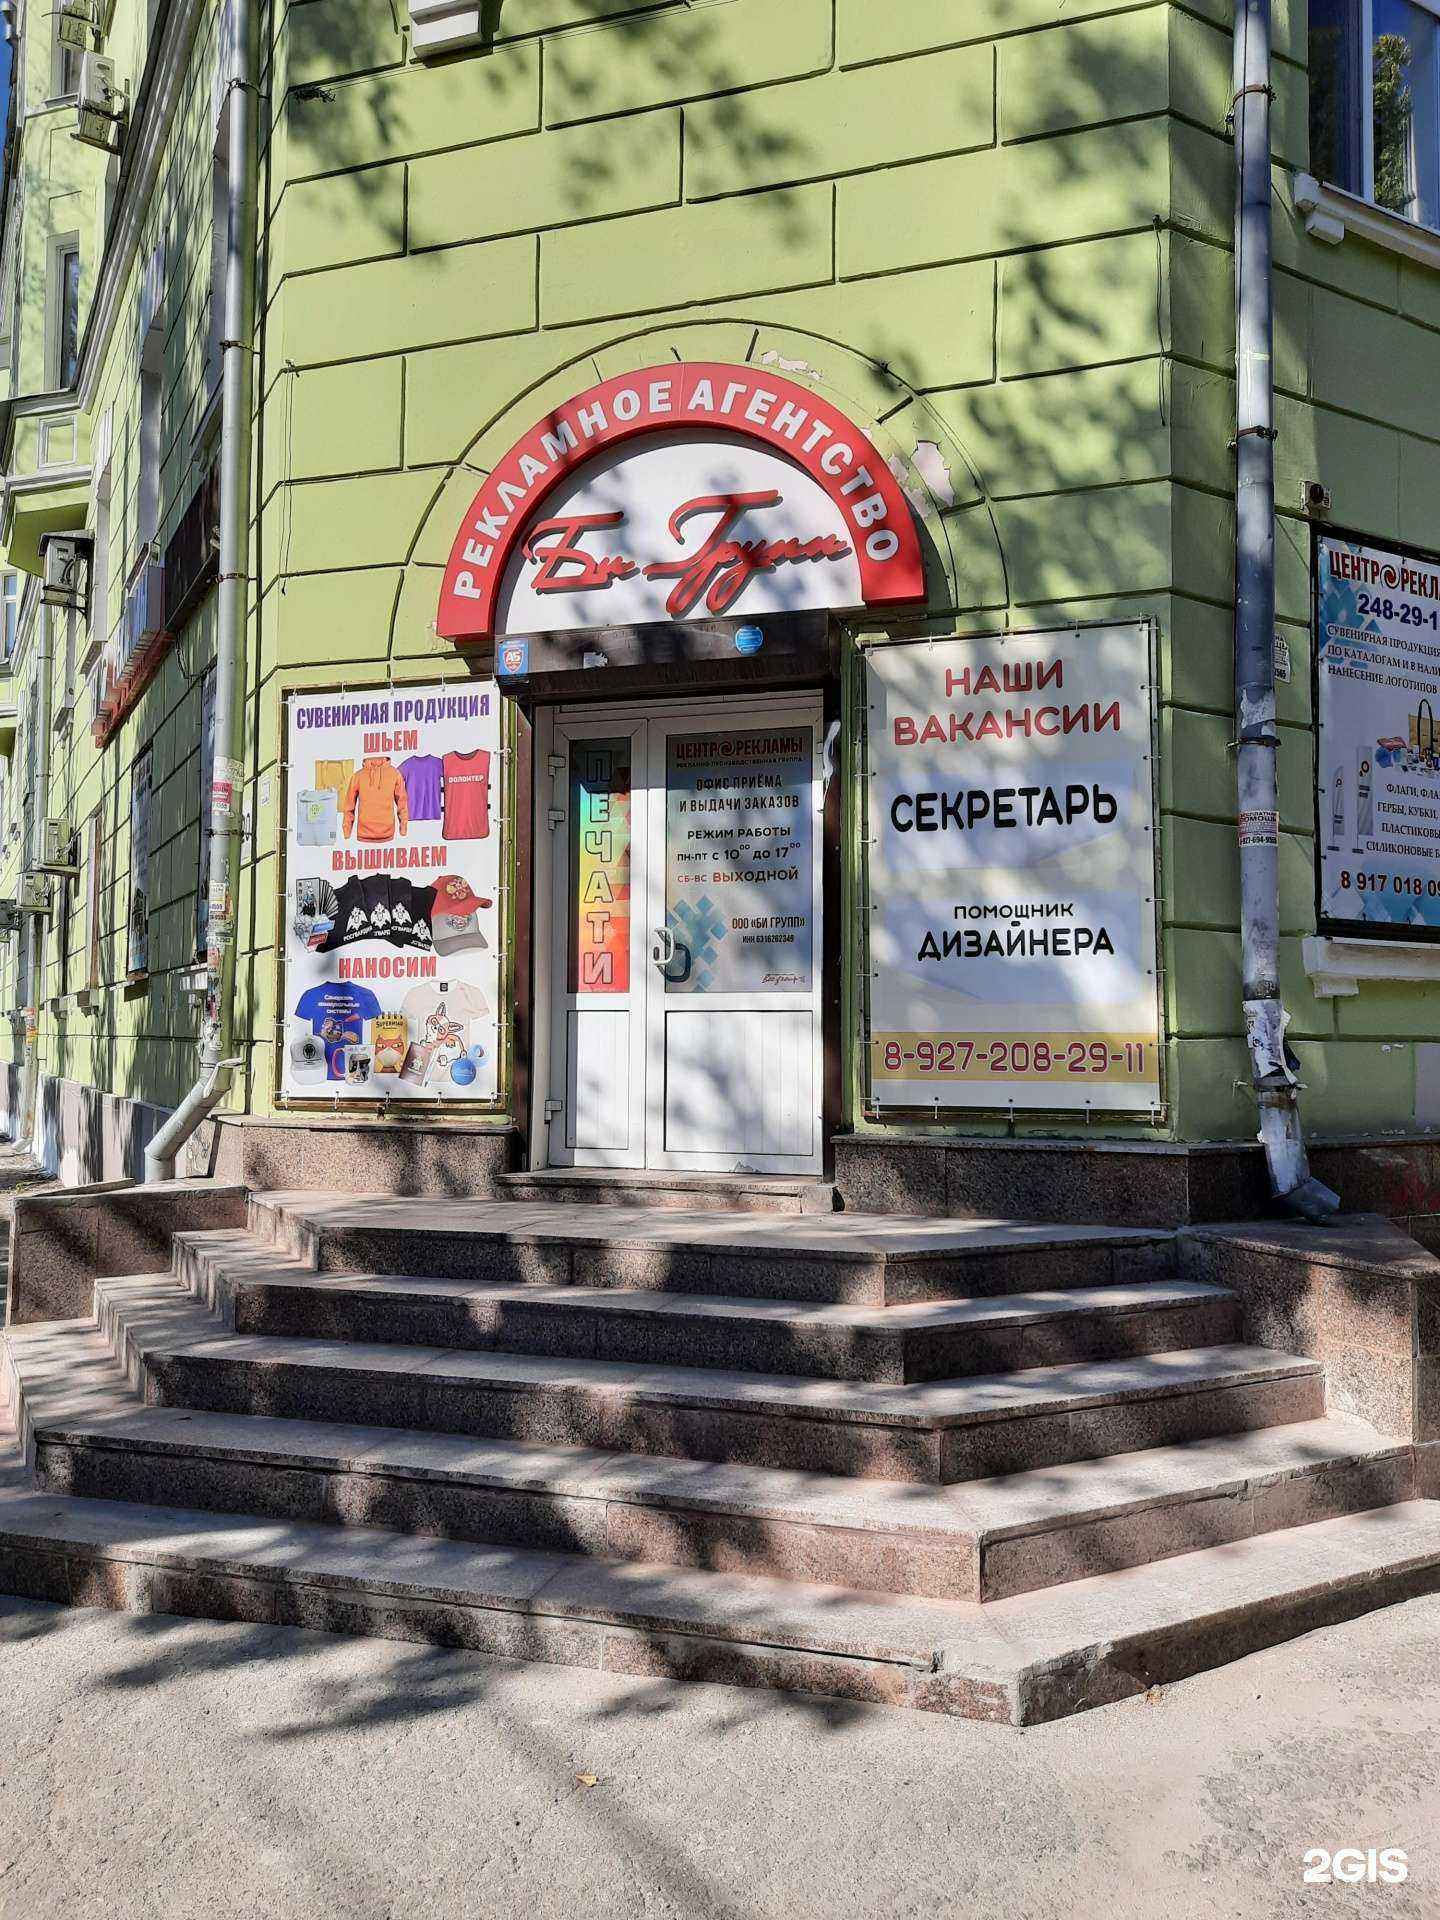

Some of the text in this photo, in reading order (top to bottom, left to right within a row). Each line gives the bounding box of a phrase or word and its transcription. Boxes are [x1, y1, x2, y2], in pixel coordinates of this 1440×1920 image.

[453, 378, 900, 600] РЕКЛАМНОЕ АГЕНТСТВО
[1329, 550, 1440, 601] ЦЕНТР РЕКЛ
[1327, 625, 1388, 646] СУВЕНИРНАЯ
[1327, 645, 1342, 656] ПО
[1344, 647, 1401, 668] КАТАЛОГАМ
[1402, 659, 1409, 670] И
[1410, 661, 1416, 671] В
[945, 658, 1064, 697] НАШИ
[1328, 665, 1437, 694] НАНЕСЕНИЕ ЛОГОТИПОВ
[296, 694, 490, 730] СУВЕНИРНАЯ ПРОДУКЦИЯ
[893, 701, 1121, 746] ВАКАНСИИ
[363, 730, 418, 753] ШЬЕМ
[736, 737, 803, 756] РЕКЛАМЫ
[696, 773, 782, 791] ОФИС ПРИЁМА
[1386, 783, 1440, 799] ФЛАГИ, ФЛА
[680, 795, 800, 813] И ВЫДАЧИ ЗАКАЗОВ
[890, 783, 1118, 833] СЕКРЕТАРЬ
[1377, 801, 1438, 820] ГЕРБЫ, КУБКИ,
[688, 826, 791, 839] РЕЖИМ РАБОТЫ
[332, 846, 447, 871] ВЫШИВАЕМ
[1366, 840, 1433, 858] СИЛИКОНОВЫЕ
[583, 750, 614, 985] ПЕЧАТИ
[712, 865, 798, 883] ВЫХОДНОЙ
[1341, 870, 1351, 889] 8
[1356, 872, 1388, 892] 917
[1393, 876, 1423, 896] 018
[732, 918, 749, 929] ООО
[770, 916, 805, 928] ГРУПП»
[954, 902, 1073, 921] ПОМОЩНИК
[742, 935, 755, 943] ИНН
[917, 920, 1115, 961] ДИЗАЙНЕРА
[338, 956, 437, 978] НАНОСИМ
[883, 1040, 1145, 1074] 8-927-208-29-11
